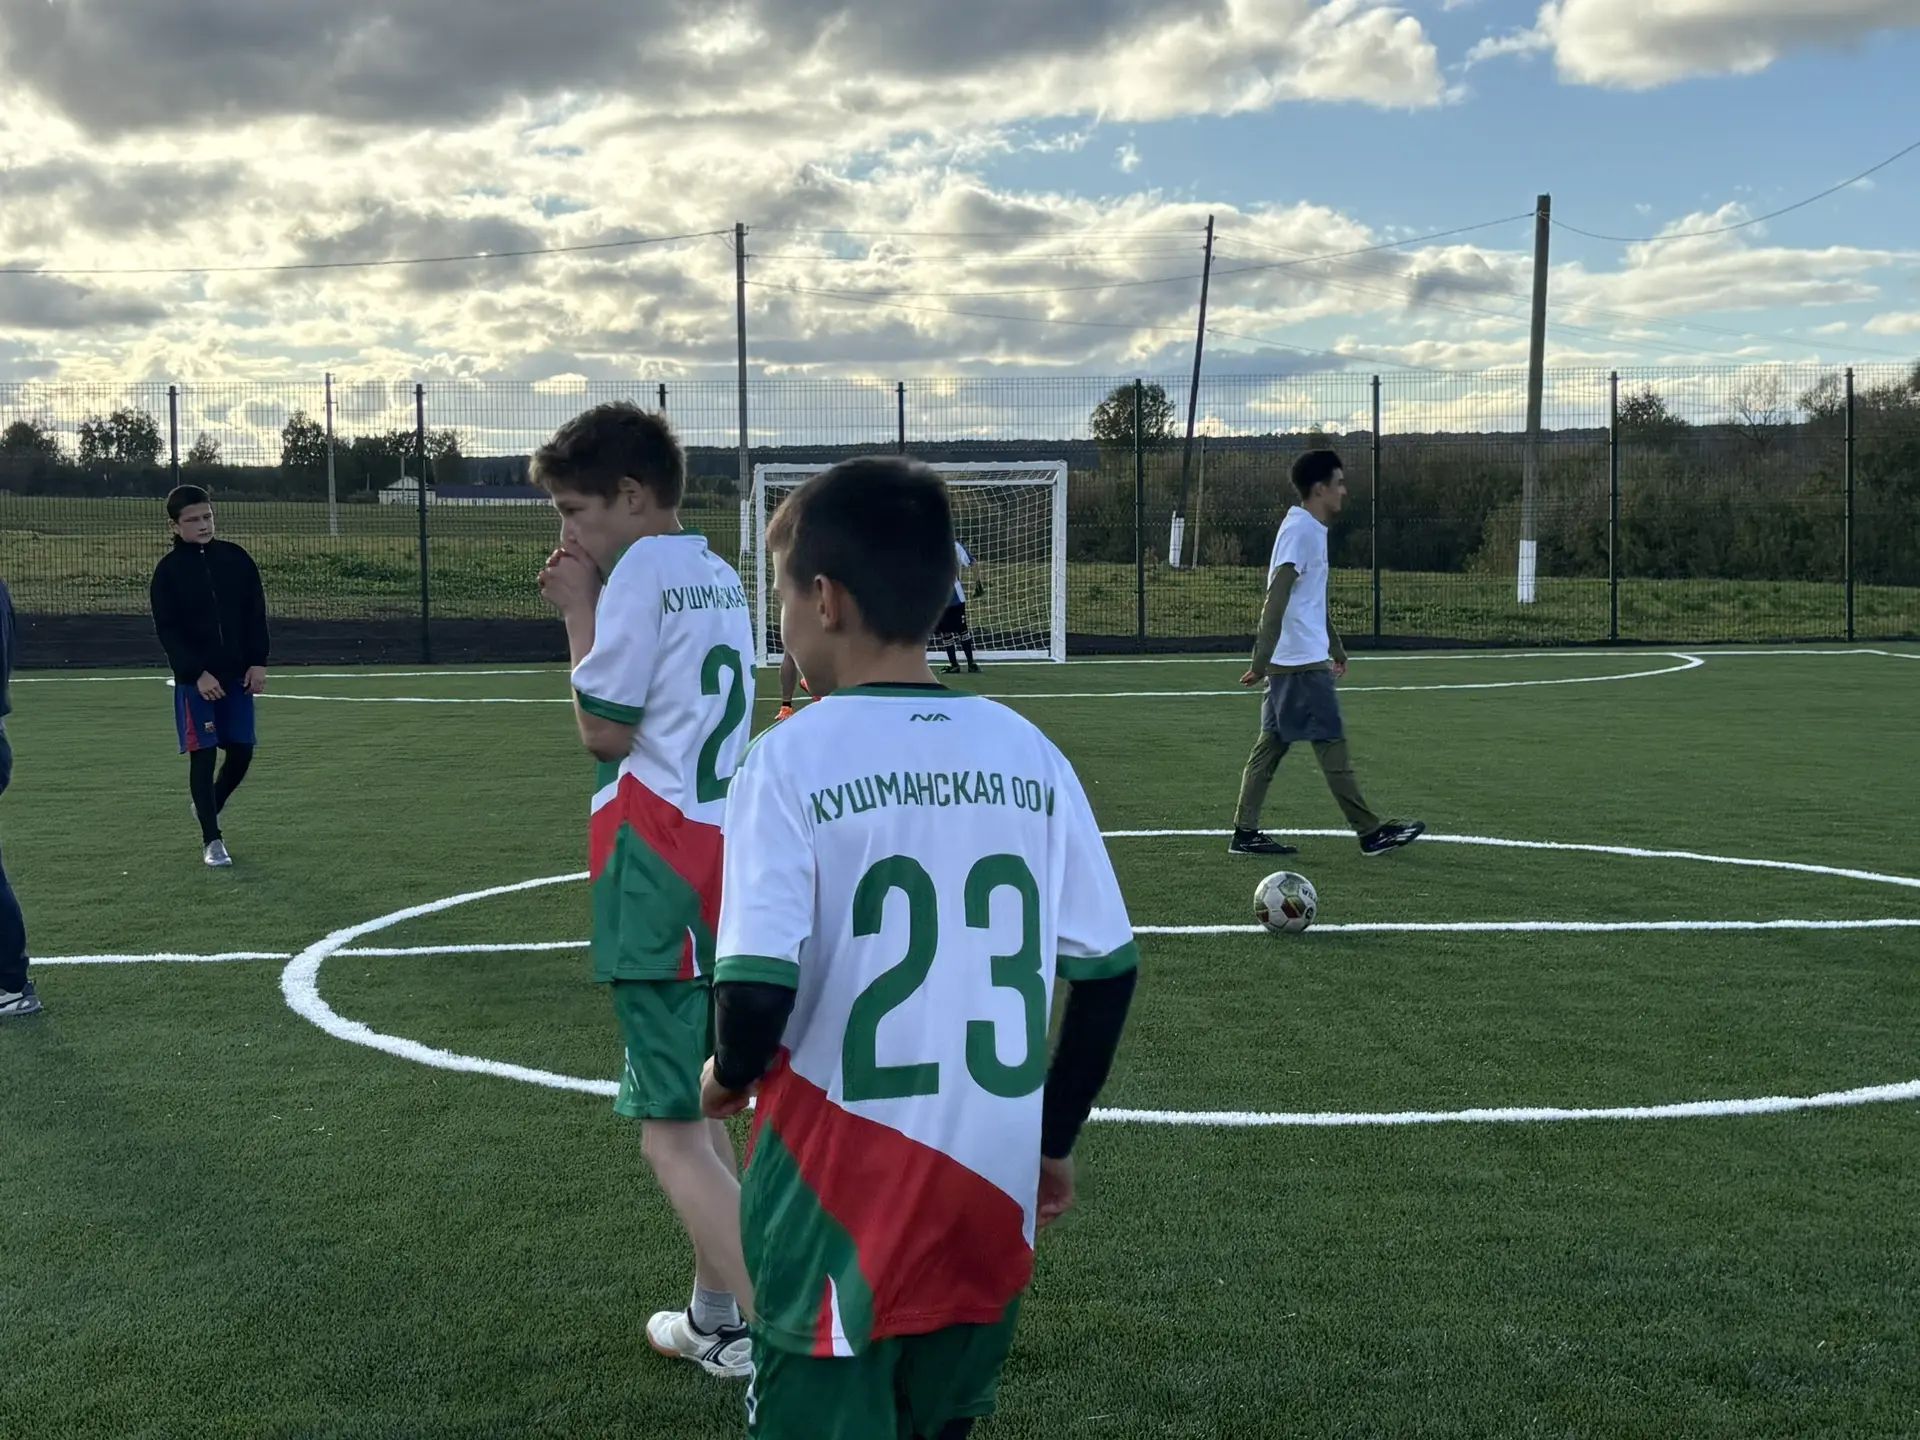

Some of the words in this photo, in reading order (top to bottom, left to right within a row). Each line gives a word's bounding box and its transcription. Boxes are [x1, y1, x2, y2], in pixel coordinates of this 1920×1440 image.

[696, 643, 756, 803] 2
[810, 771, 1006, 824] КУШМАНСКАЯ
[842, 854, 1047, 1101] 23
